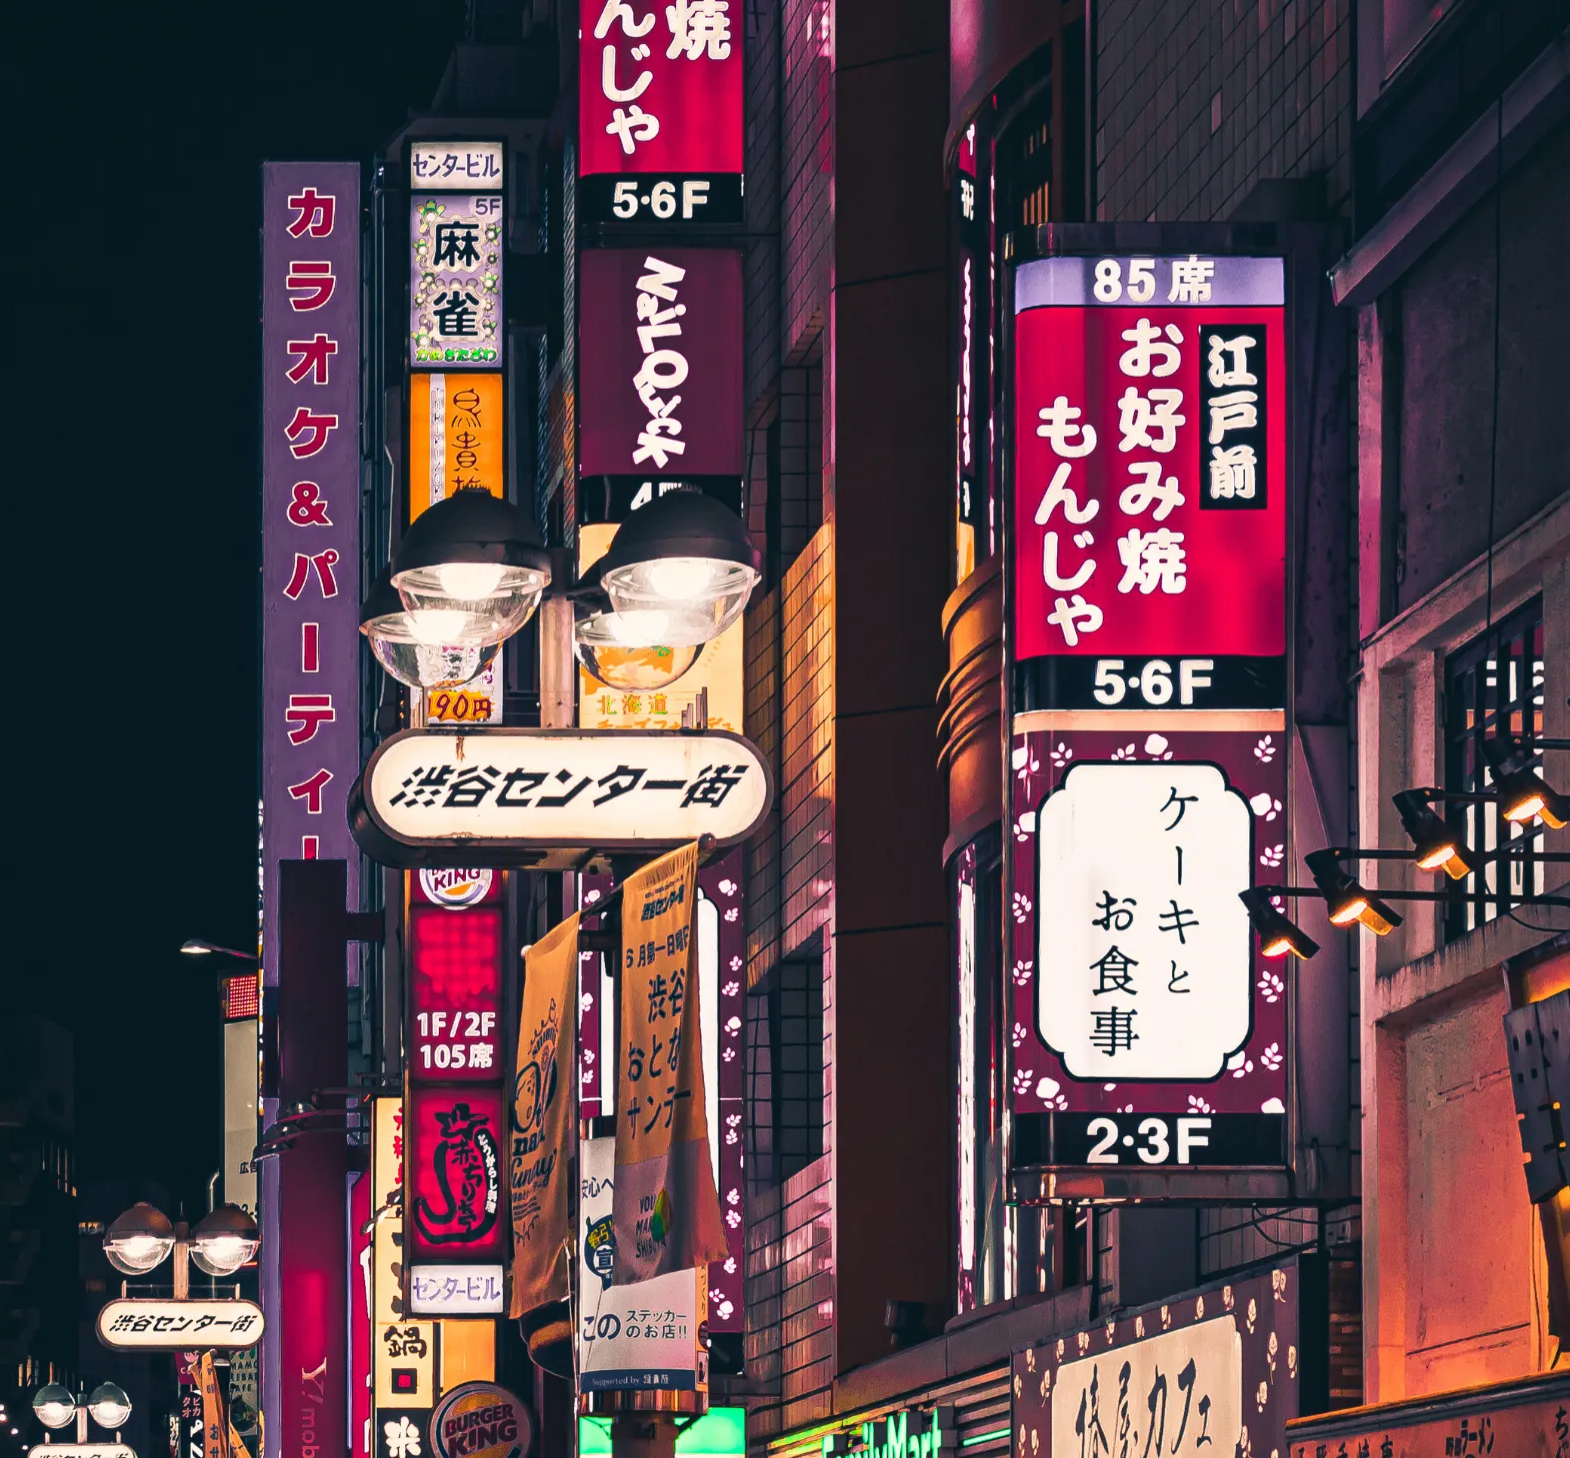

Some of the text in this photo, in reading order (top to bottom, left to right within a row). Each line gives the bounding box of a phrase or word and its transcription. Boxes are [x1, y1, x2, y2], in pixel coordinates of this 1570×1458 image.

[413, 153, 500, 178] センタービル
[475, 199, 500, 215] 5F
[434, 221, 481, 336] 麻雀
[1093, 255, 1215, 303] 85席
[1208, 334, 1258, 499] 江戸前
[1118, 318, 1186, 594] お好み焼
[1034, 396, 1103, 647] もんじゃ
[389, 765, 749, 809] 渋谷センター街
[1158, 786, 1199, 995] ケーキと
[1089, 890, 1140, 1056] お食事
[647, 968, 686, 1024] 渋谷
[419, 1044, 493, 1068] 105席
[413, 1276, 501, 1301] センタービル
[109, 1315, 258, 1333] 渋谷センター街
[584, 1313, 621, 1342] この
[626, 1309, 687, 1323] ステッカー
[630, 1376, 640, 1388] by
[445, 1404, 515, 1438] BURGER
[448, 1419, 518, 1458] KING
